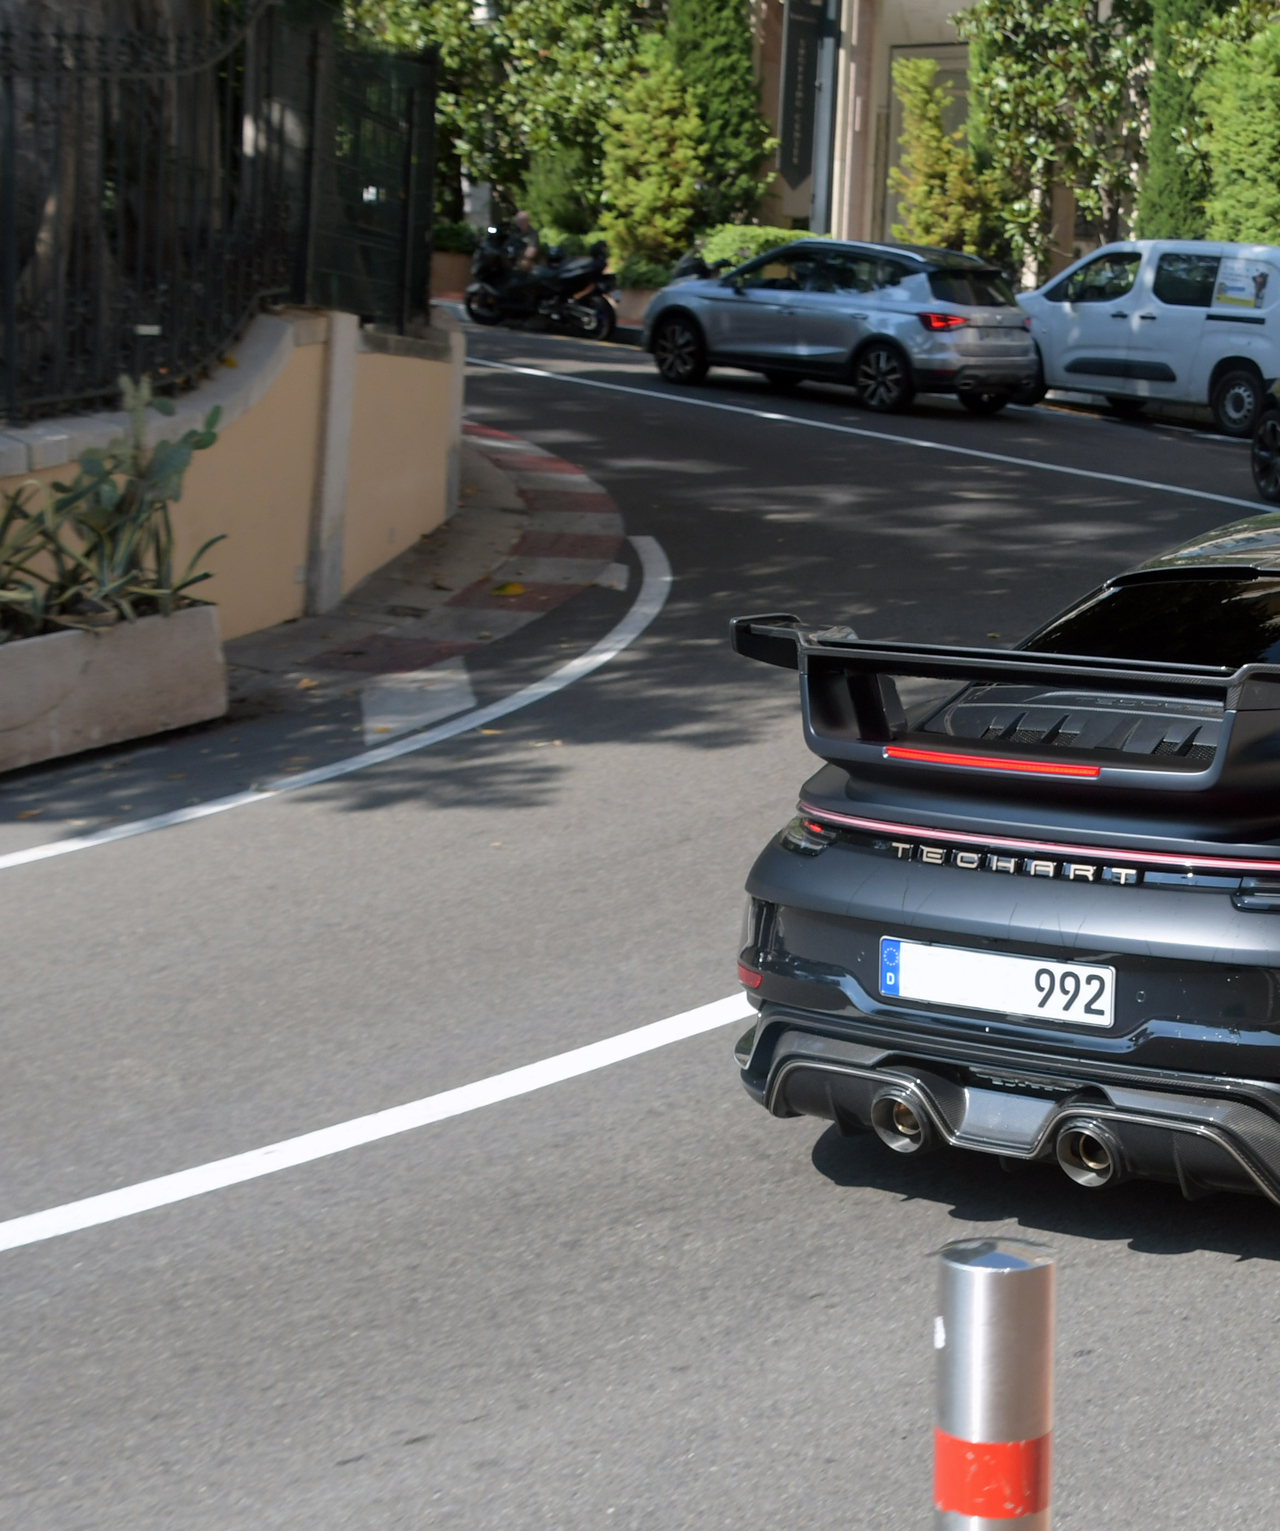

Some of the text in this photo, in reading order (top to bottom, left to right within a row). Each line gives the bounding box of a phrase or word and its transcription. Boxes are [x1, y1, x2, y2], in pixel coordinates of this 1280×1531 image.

[891, 841, 1138, 885] TECHART
[885, 971, 895, 985] D
[1034, 967, 1107, 1017] 992
